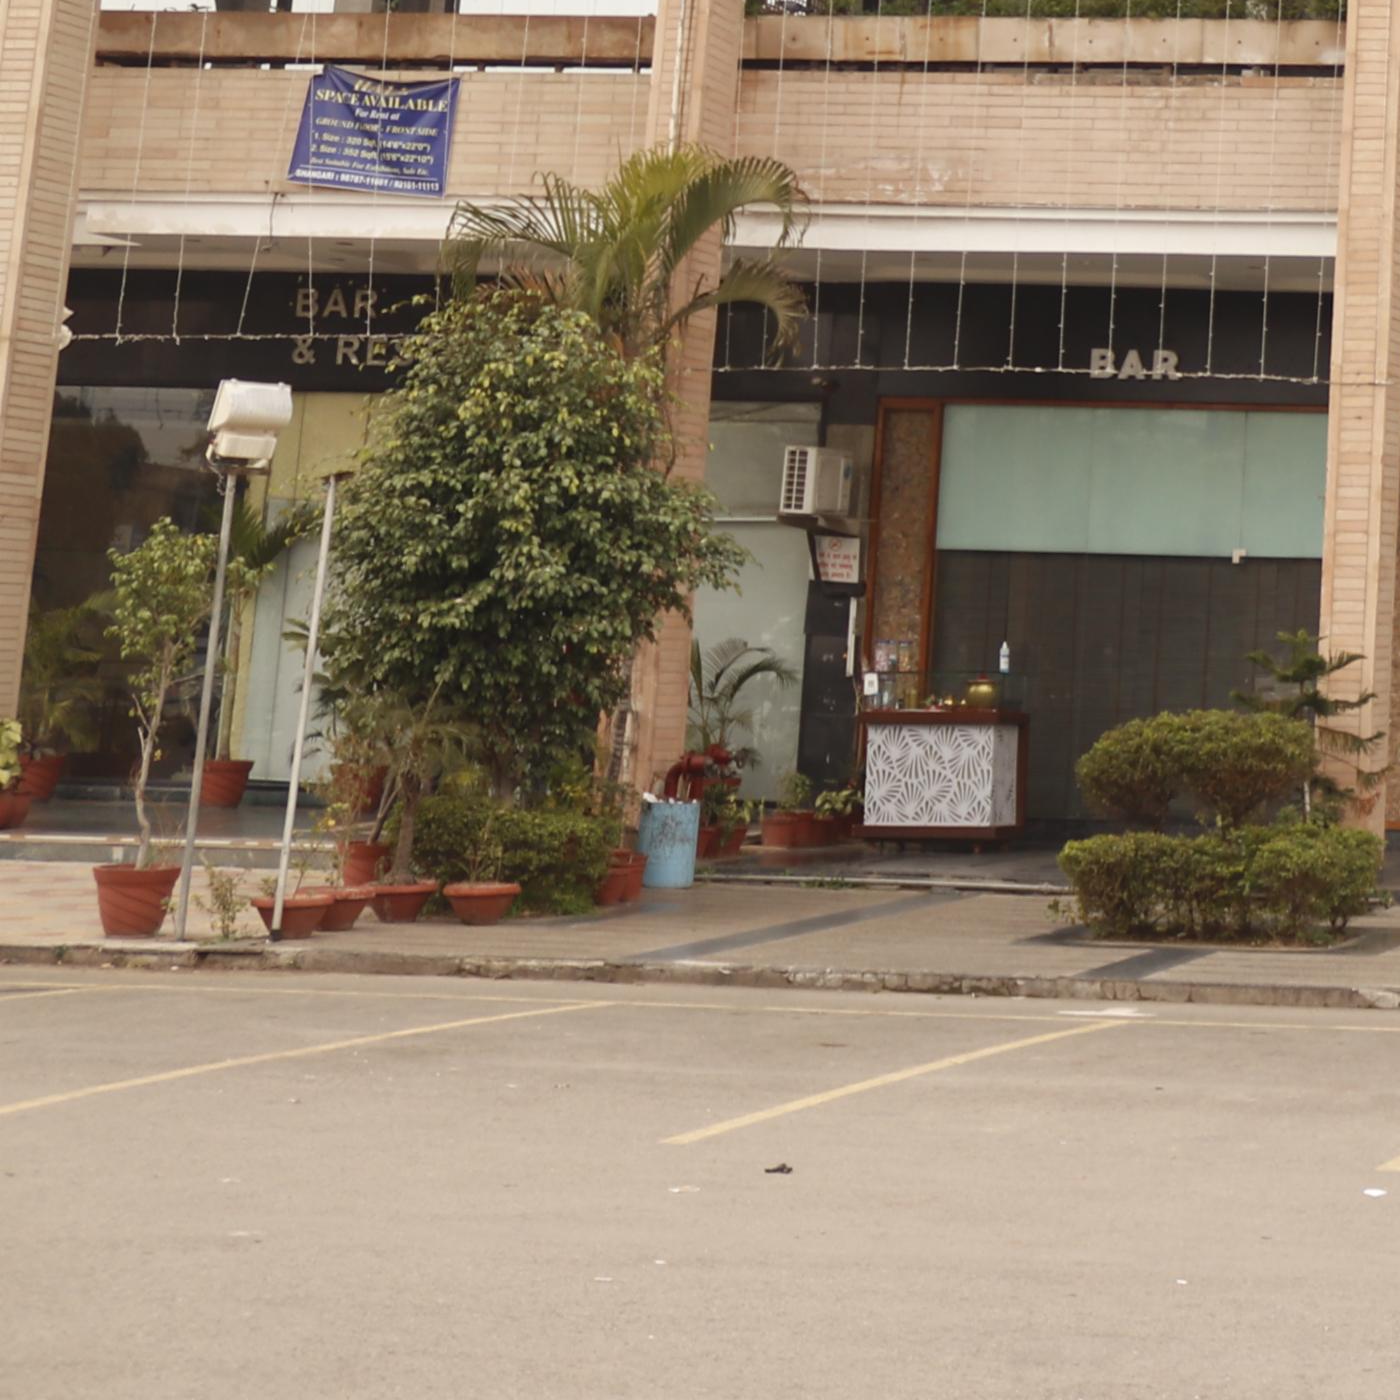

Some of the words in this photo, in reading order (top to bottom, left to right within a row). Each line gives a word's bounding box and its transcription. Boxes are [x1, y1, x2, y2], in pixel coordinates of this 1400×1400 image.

[361, 94, 448, 112] AVAILABLE
[355, 107, 369, 118] For
[370, 109, 389, 120] Rent
[322, 131, 340, 142] Size
[320, 144, 336, 154] Size
[295, 288, 378, 319] BAR
[291, 335, 316, 365] &
[1089, 347, 1180, 380] BAR
